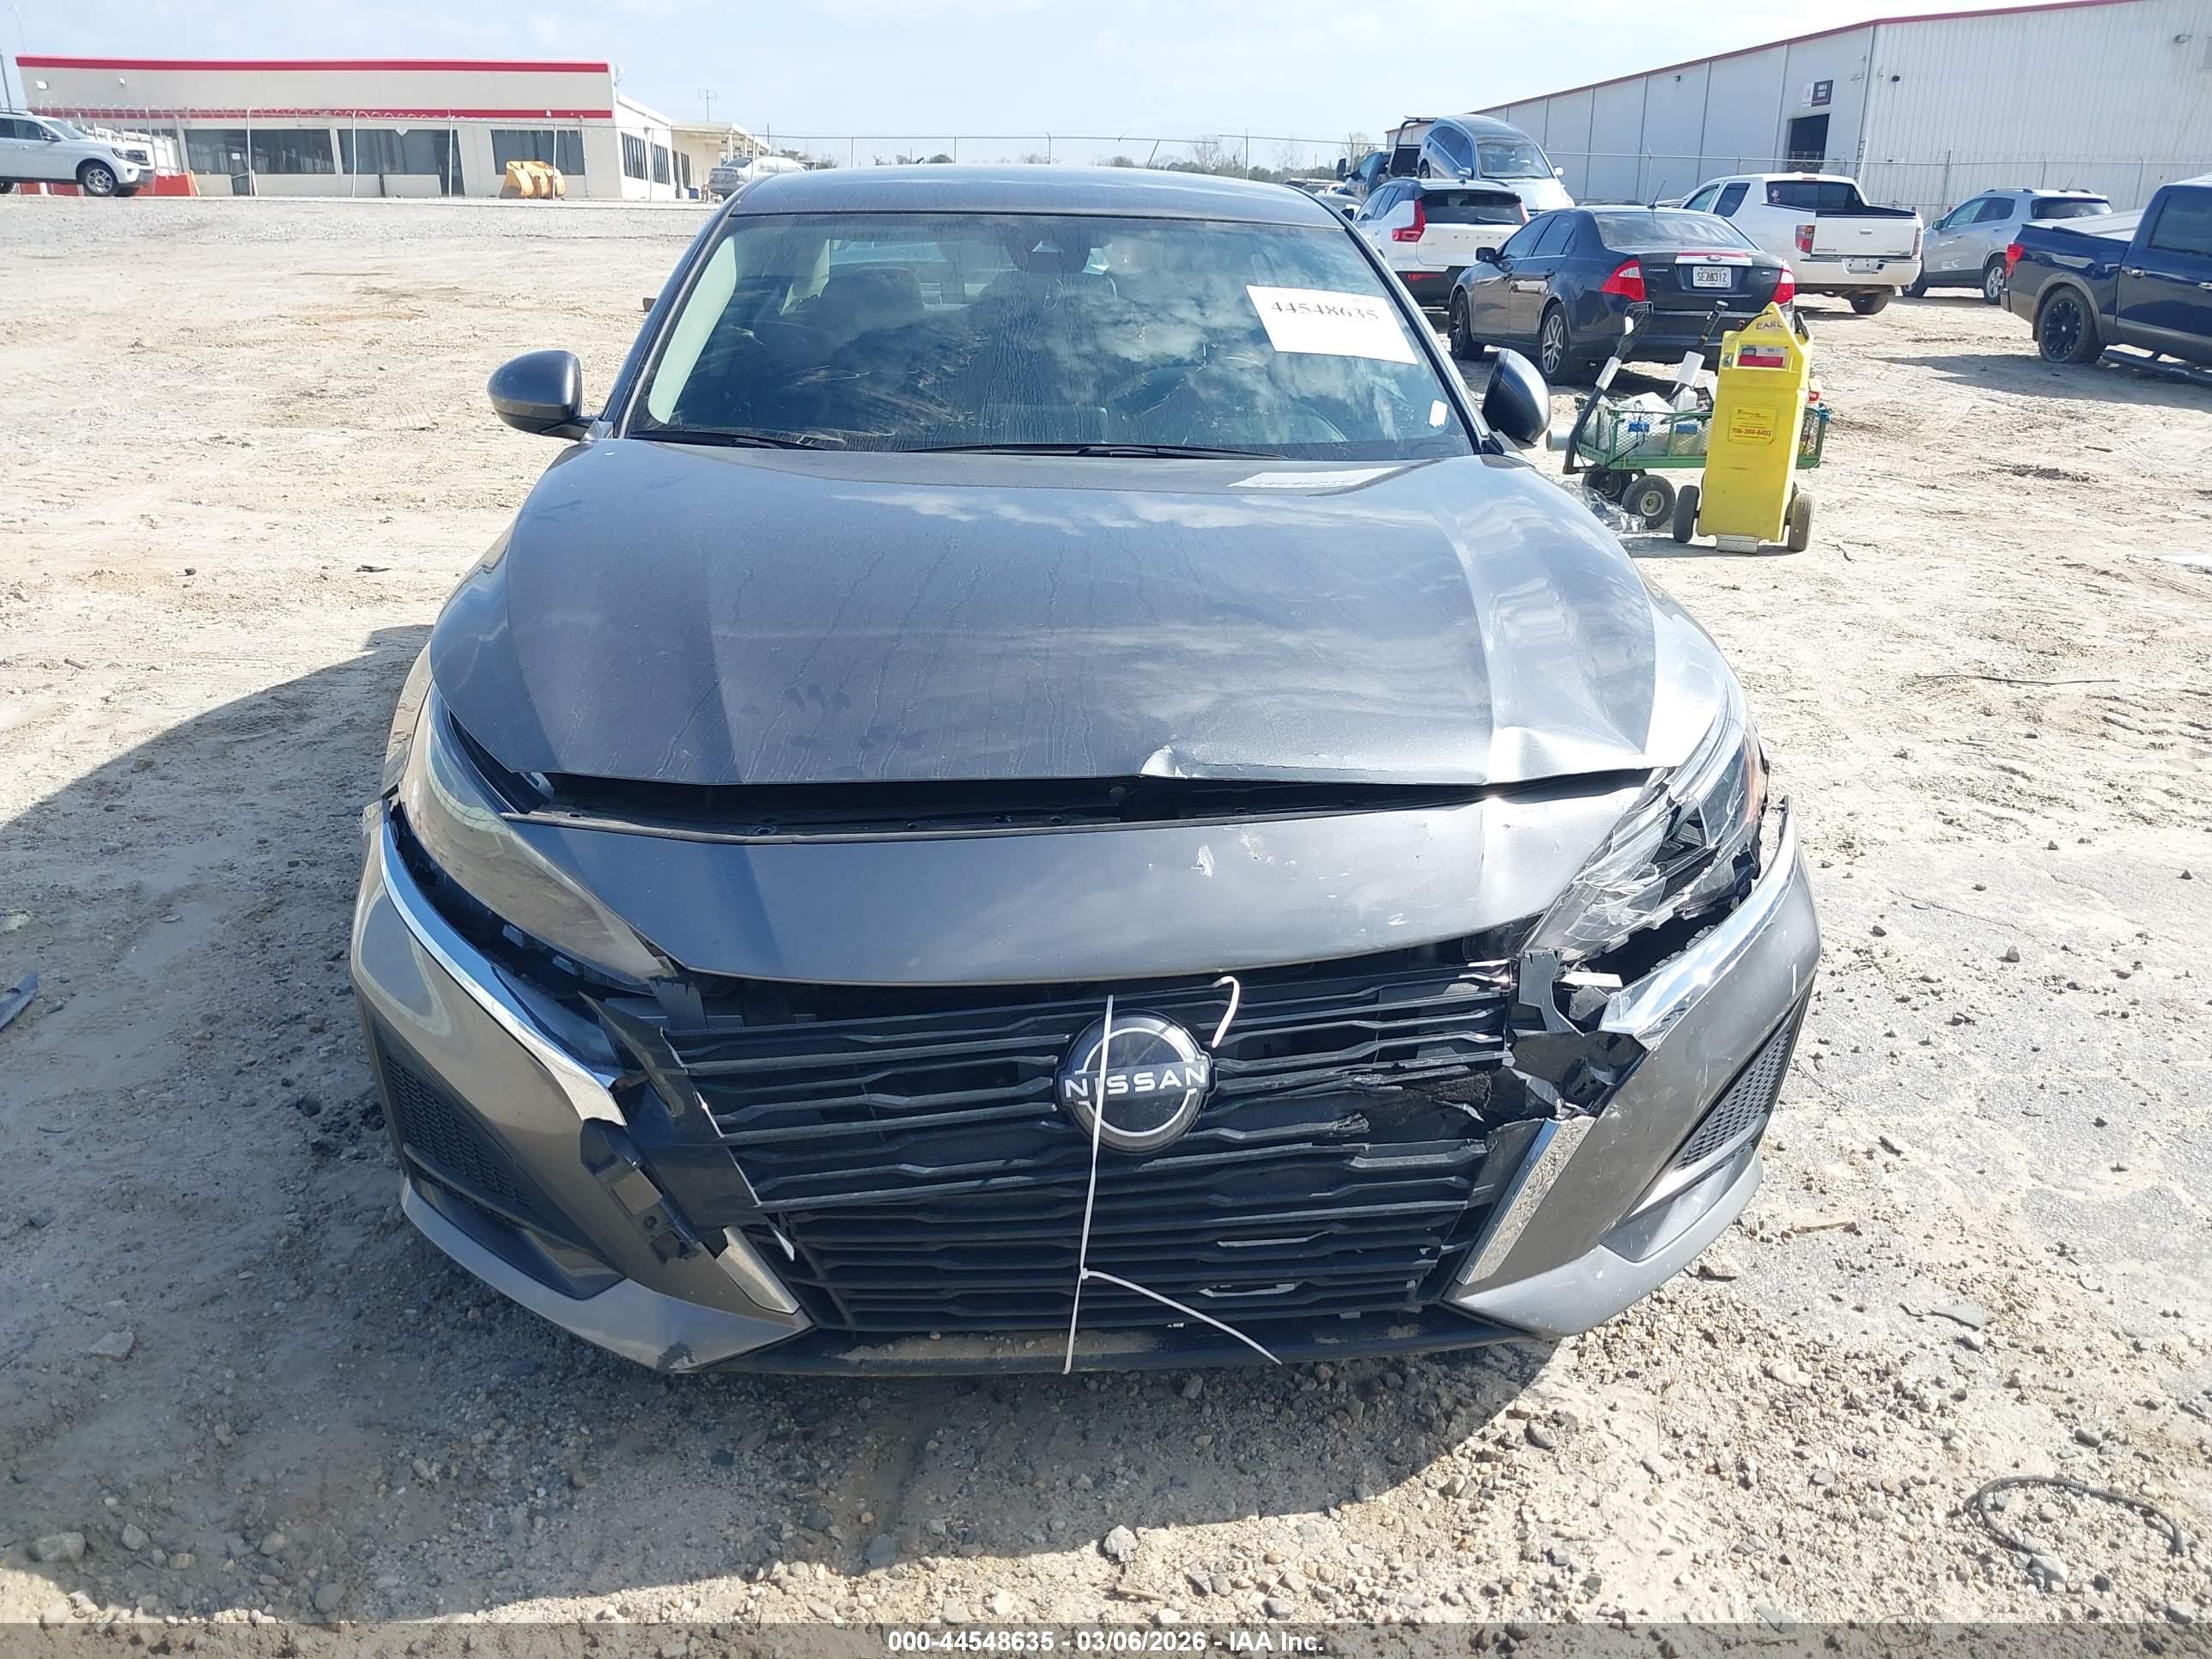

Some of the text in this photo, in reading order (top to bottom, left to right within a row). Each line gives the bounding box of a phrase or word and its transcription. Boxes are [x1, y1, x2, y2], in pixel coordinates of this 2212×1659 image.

[1271, 301, 1379, 321] 44548635
[1756, 320, 1784, 330] EARL
[1064, 1064, 1206, 1098] NISSAN
